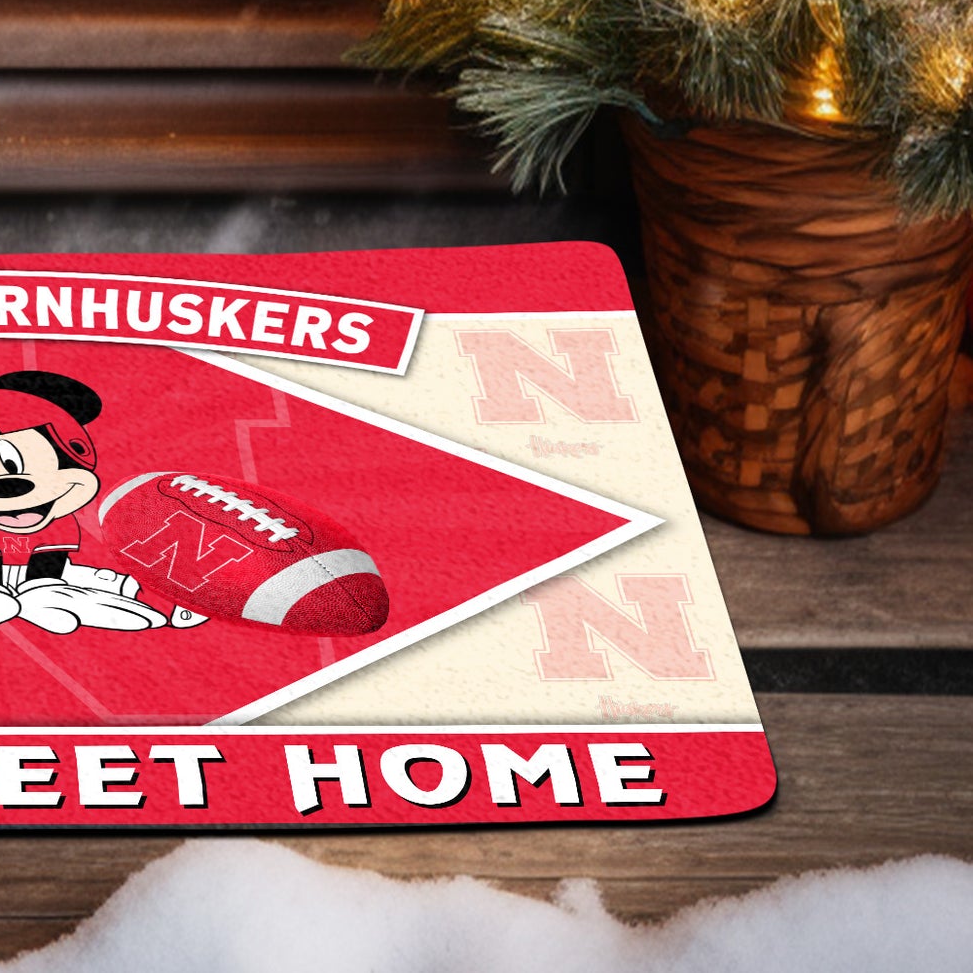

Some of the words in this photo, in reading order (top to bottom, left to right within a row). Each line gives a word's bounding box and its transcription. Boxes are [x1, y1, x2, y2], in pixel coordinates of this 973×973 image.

[454, 328, 640, 425] N
[2, 536, 31, 554] N
[119, 512, 255, 592] N
[523, 573, 718, 682] N
[284, 742, 669, 817] HOME
